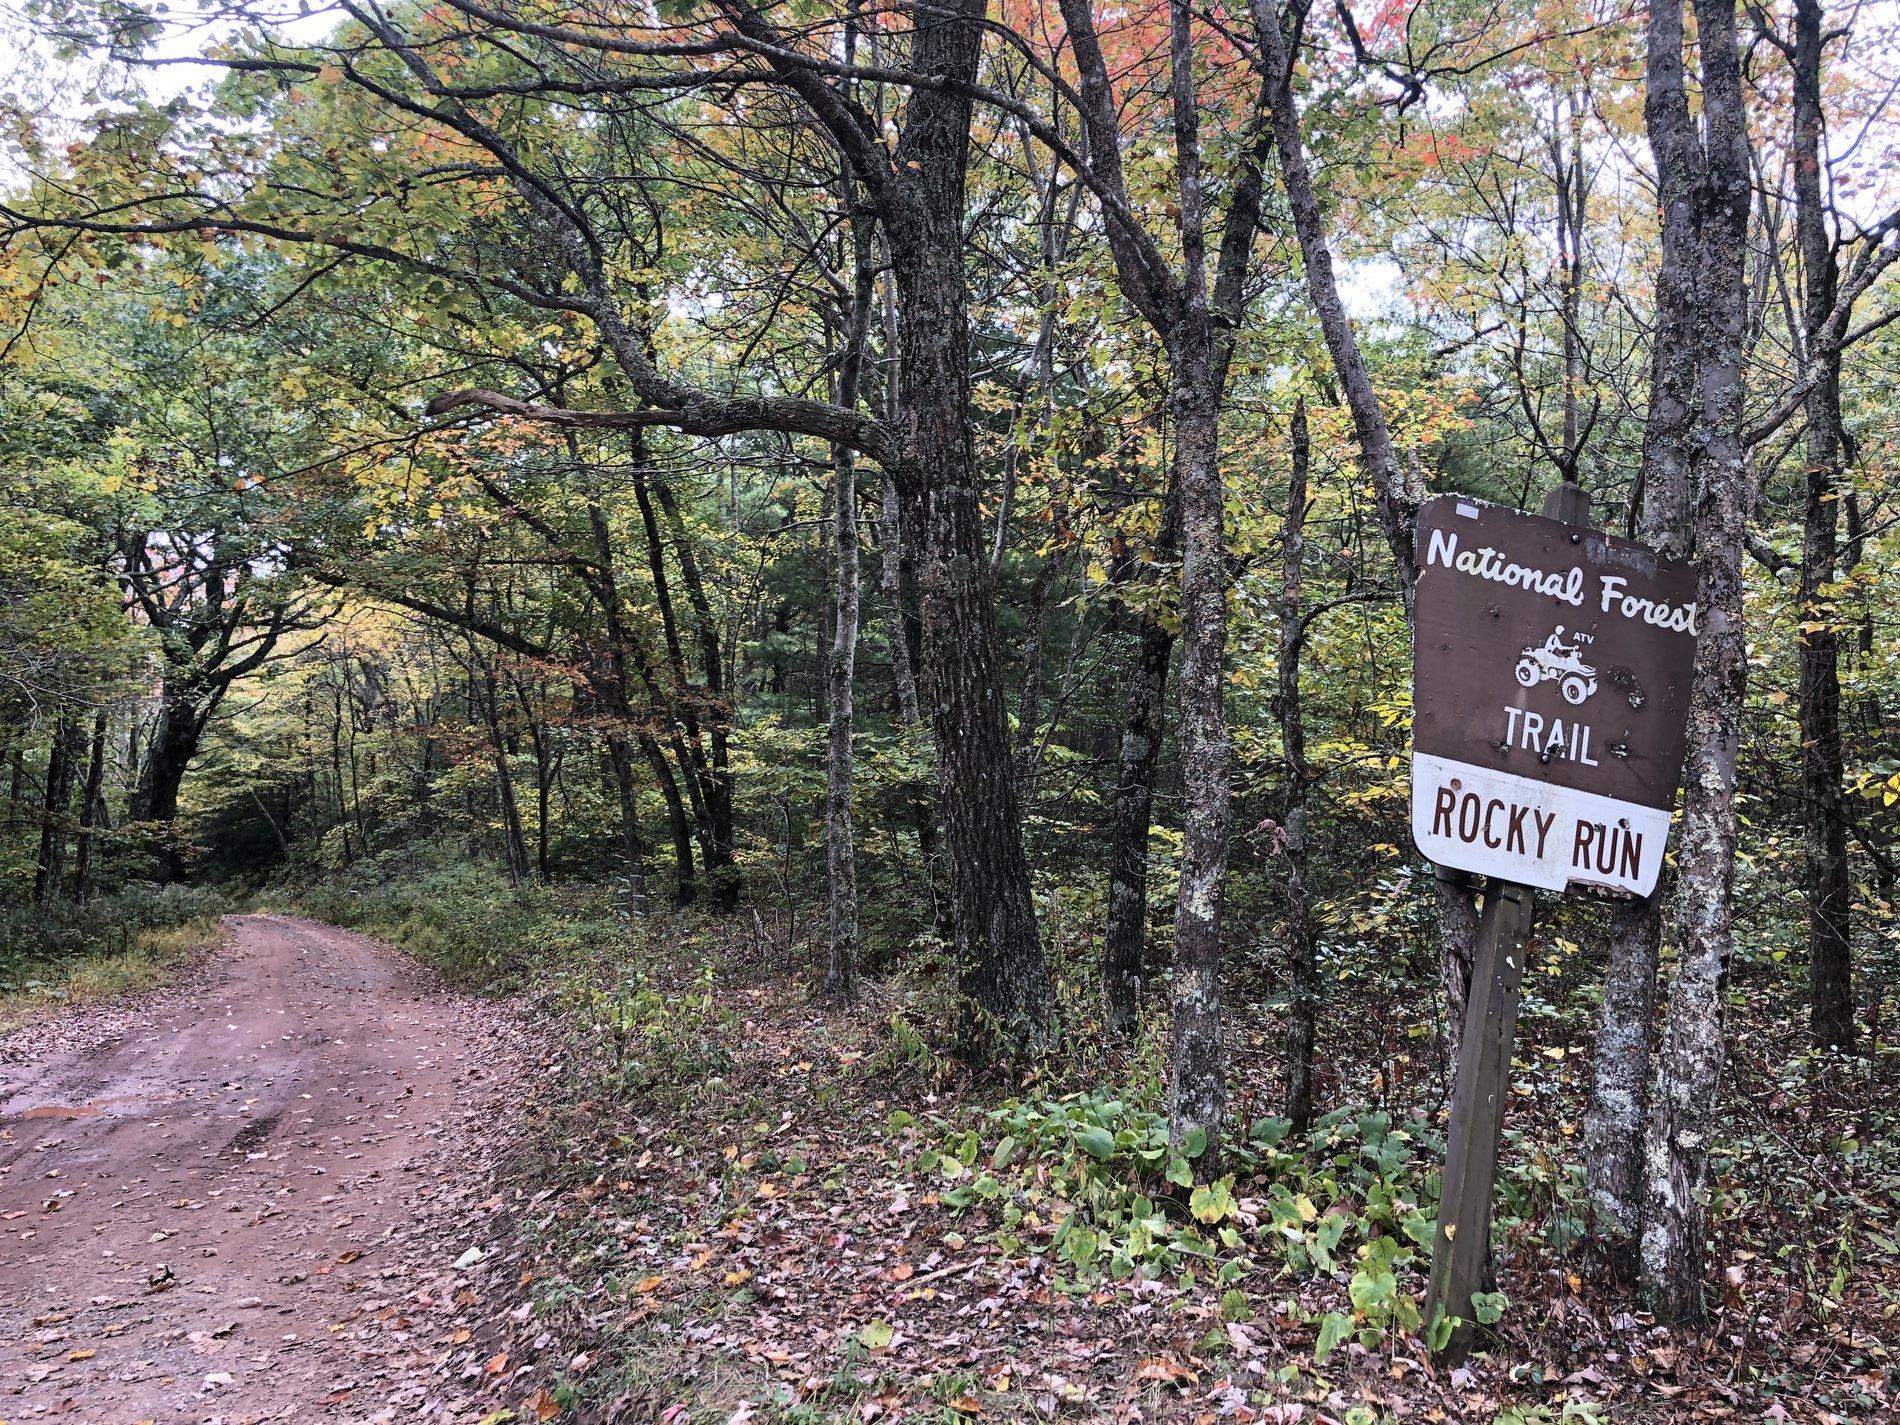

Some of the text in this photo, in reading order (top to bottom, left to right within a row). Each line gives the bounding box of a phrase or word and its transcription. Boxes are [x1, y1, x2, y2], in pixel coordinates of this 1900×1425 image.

[1427, 529, 1698, 637] National Forest
[1572, 632, 1595, 645] ATV
[1504, 705, 1598, 767] TRAIL
[1432, 786, 1643, 880] ROCKY RUN
